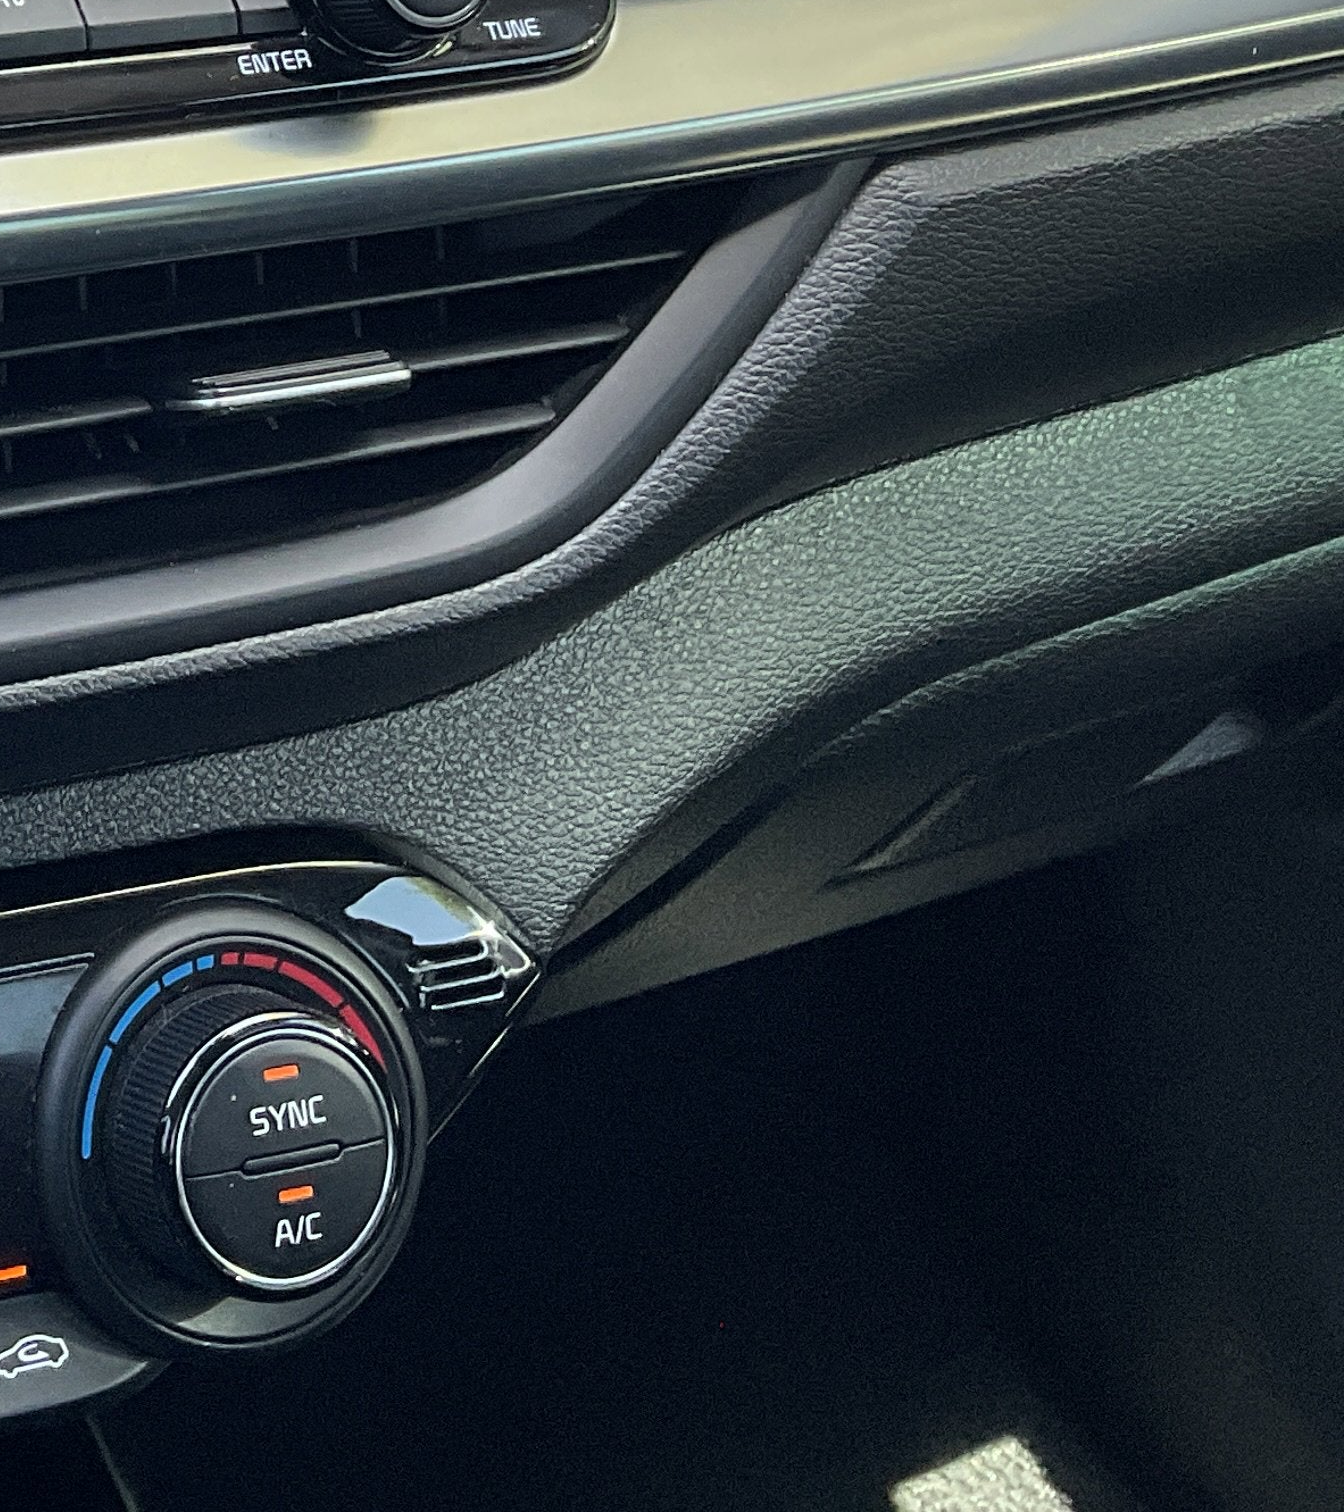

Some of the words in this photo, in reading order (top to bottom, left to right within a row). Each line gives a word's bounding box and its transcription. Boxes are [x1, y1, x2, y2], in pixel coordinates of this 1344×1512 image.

[483, 17, 542, 41] TUNE
[238, 49, 312, 76] ENTER
[249, 1095, 327, 1137] SYNC
[275, 1212, 322, 1248] A/C
